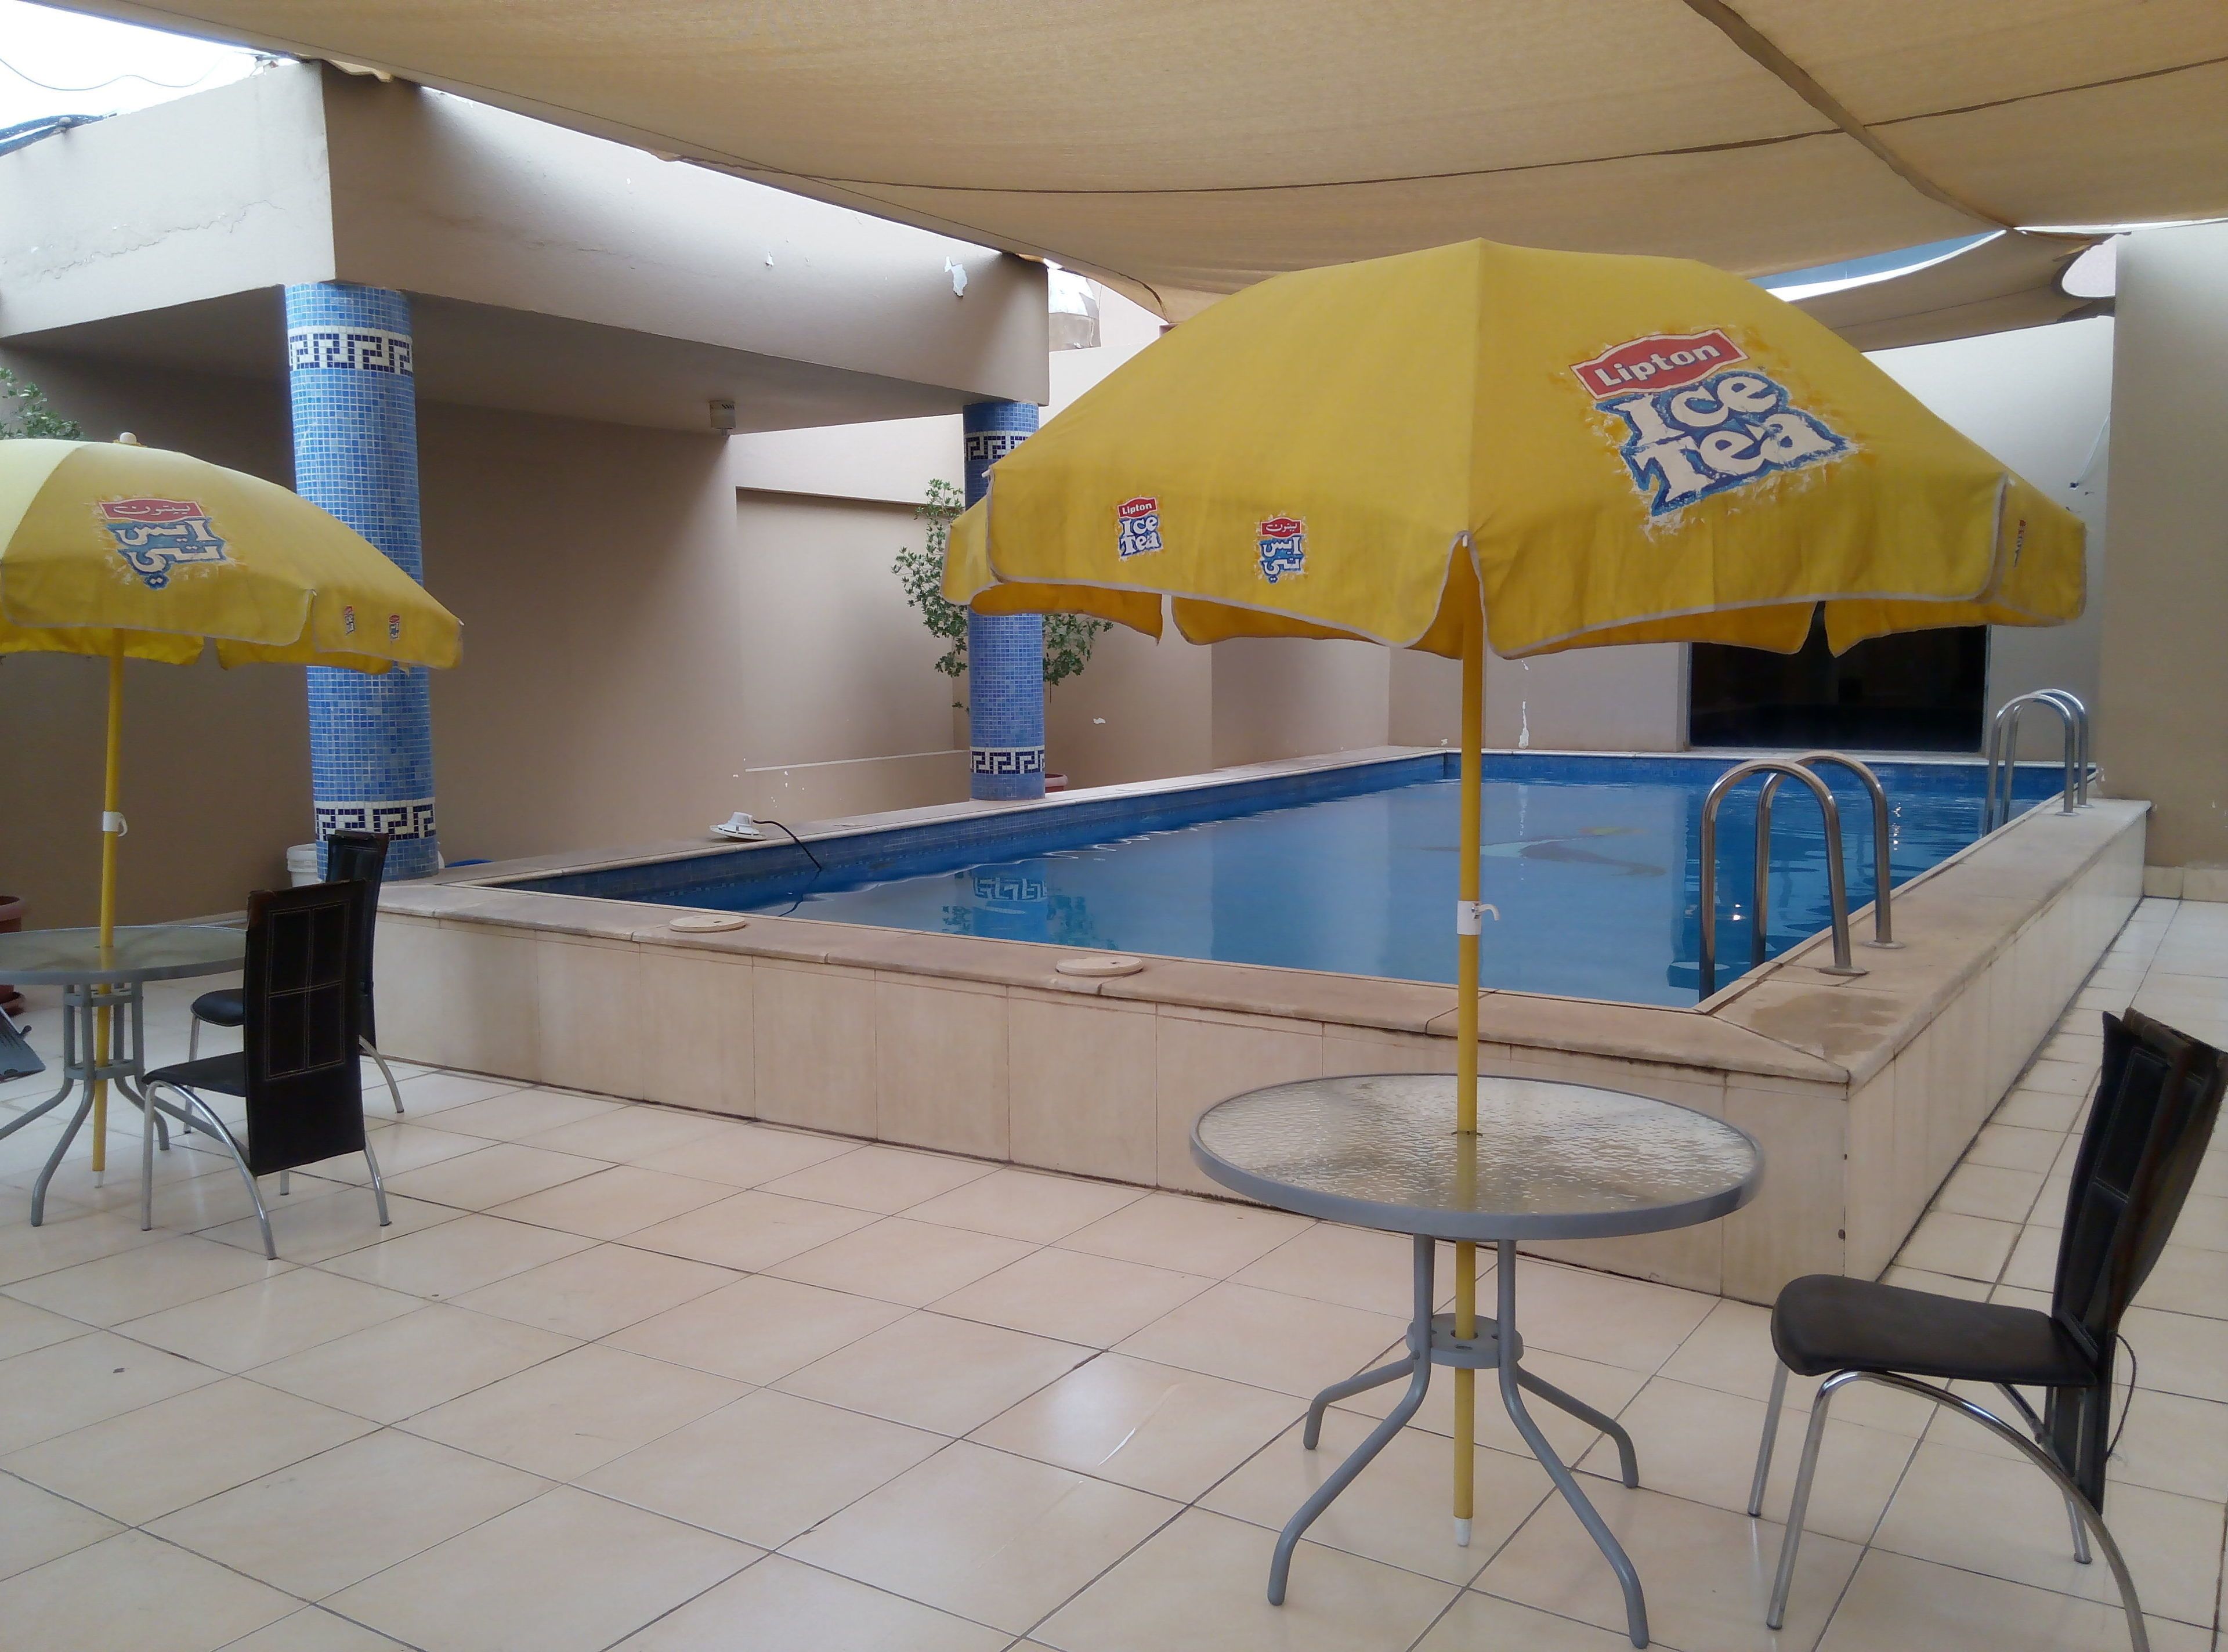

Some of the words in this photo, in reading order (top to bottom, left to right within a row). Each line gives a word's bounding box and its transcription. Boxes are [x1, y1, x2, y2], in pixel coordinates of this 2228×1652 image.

[1594, 343, 1721, 387] Lipton
[1614, 375, 1777, 446] Ice
[1633, 413, 1836, 502] Tea
[1122, 503, 1152, 515] Lipton
[1122, 516, 1158, 536] Ice
[1120, 532, 1161, 555] Tea
